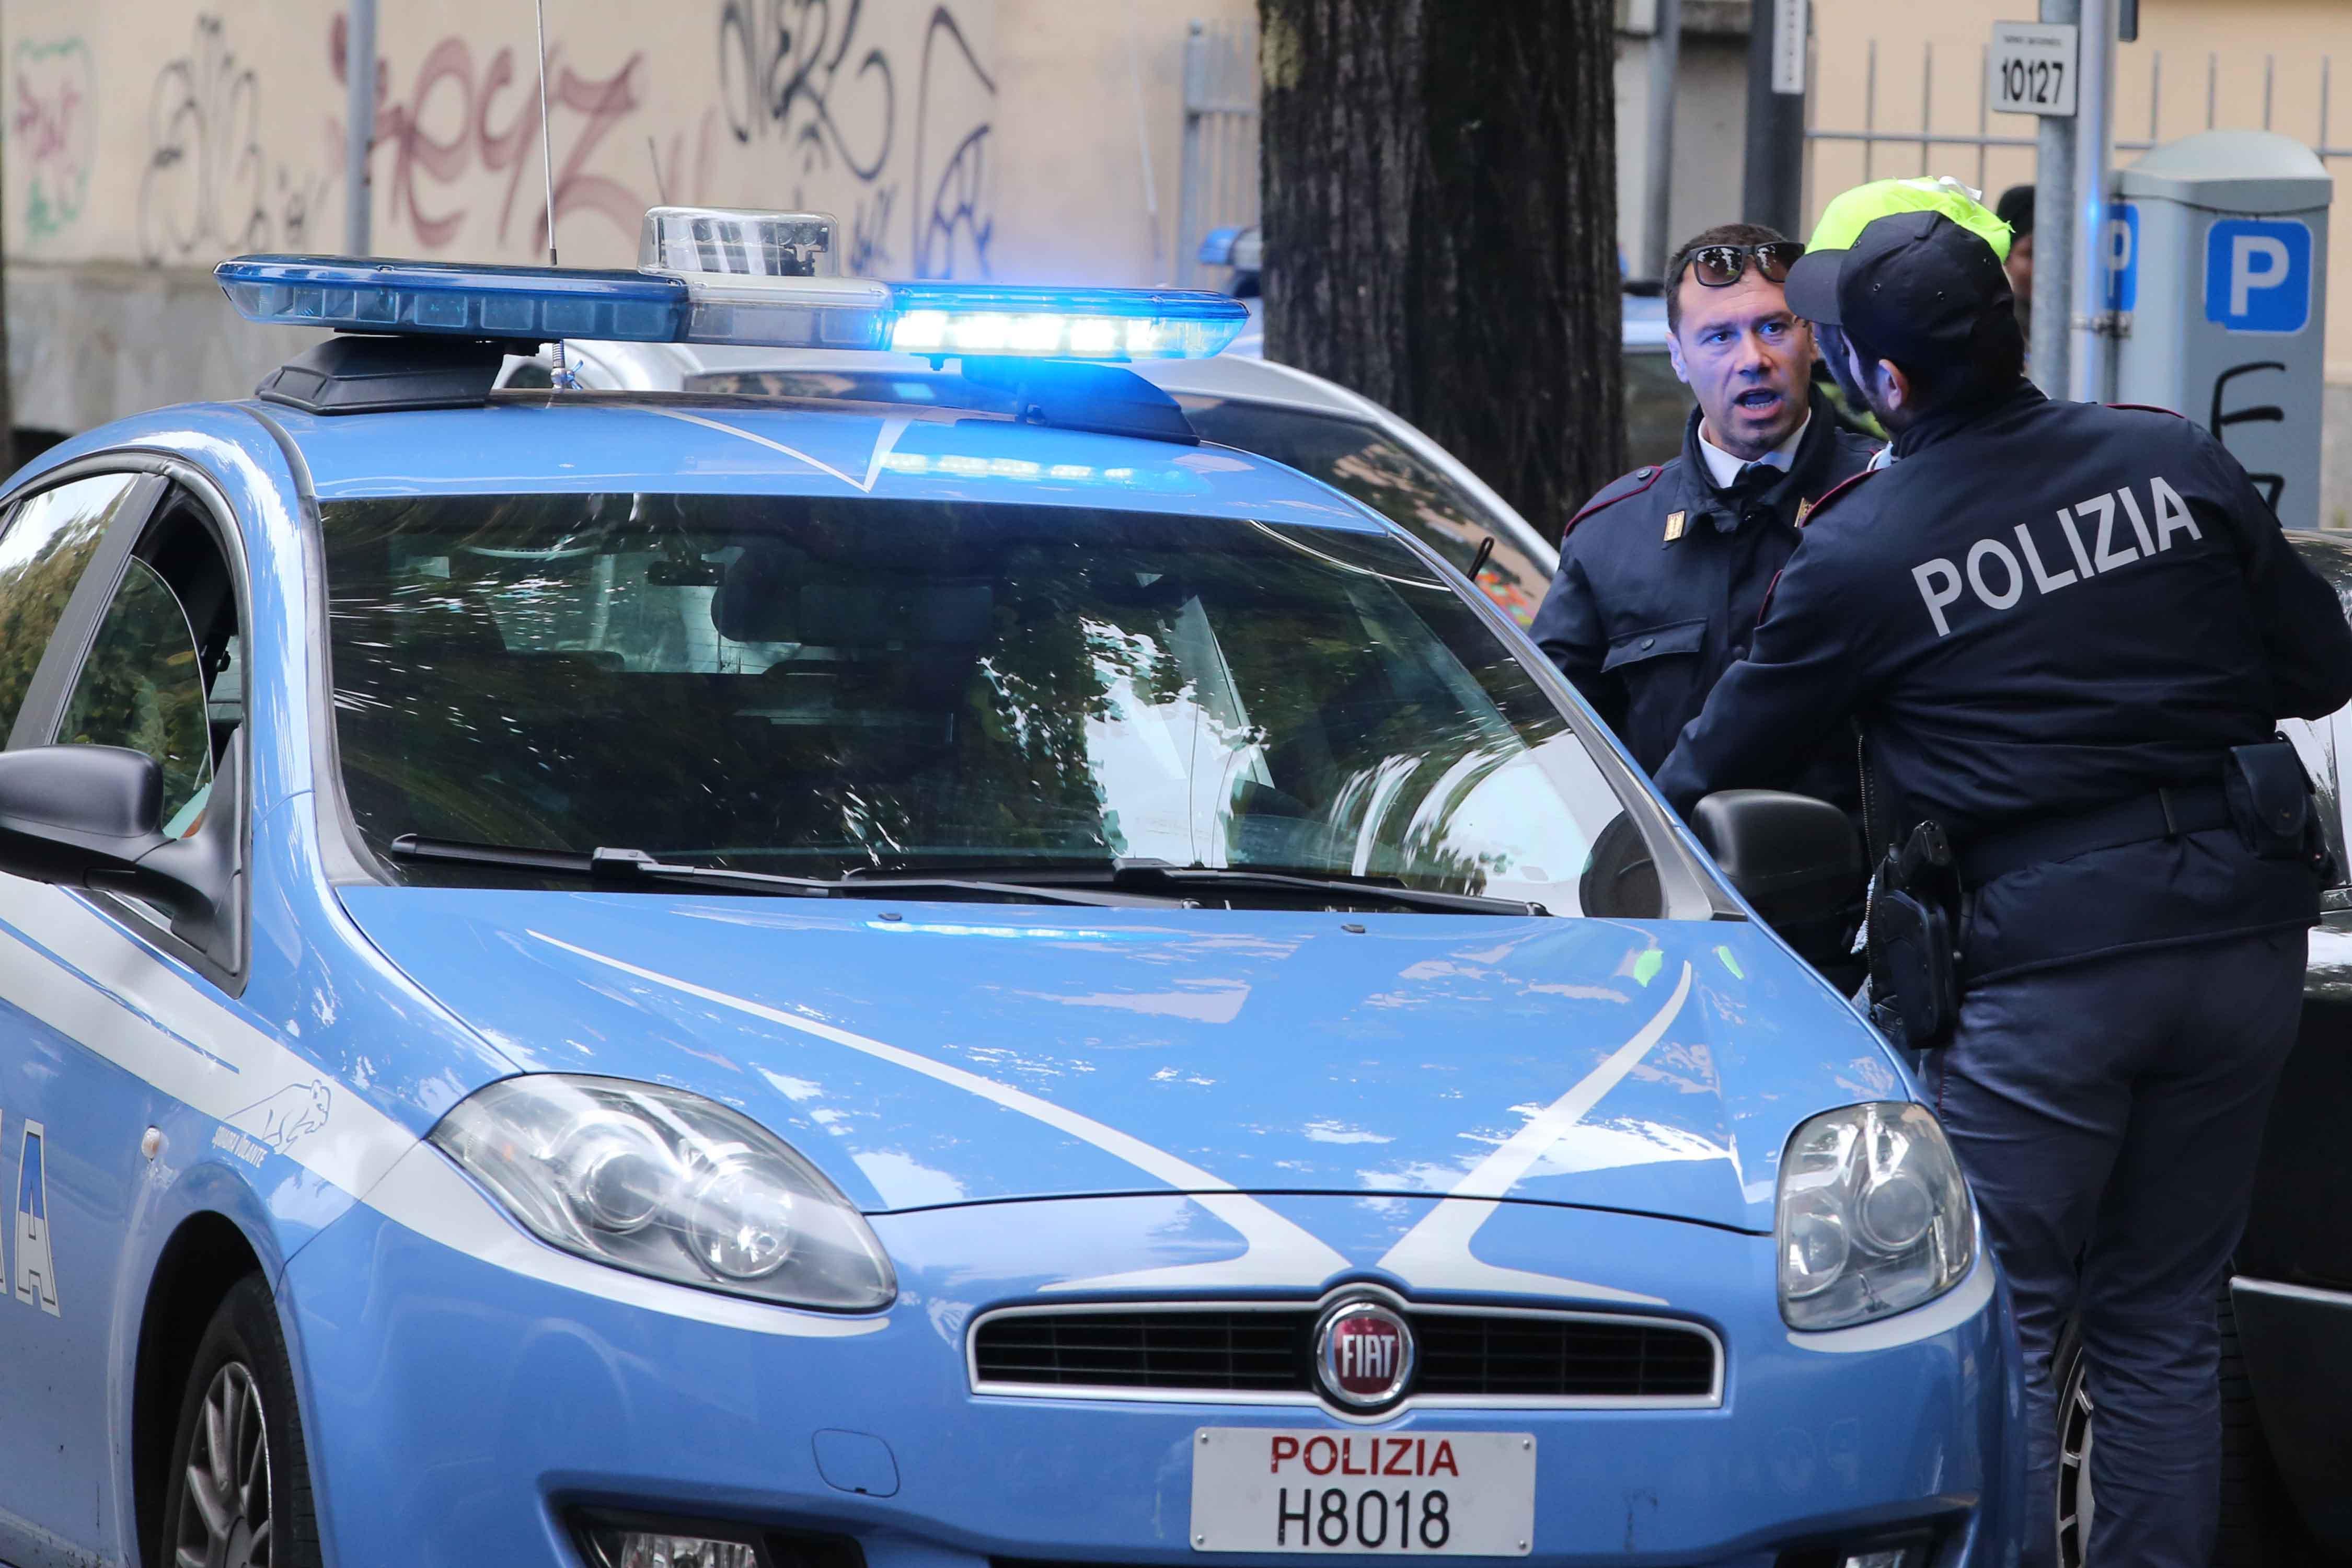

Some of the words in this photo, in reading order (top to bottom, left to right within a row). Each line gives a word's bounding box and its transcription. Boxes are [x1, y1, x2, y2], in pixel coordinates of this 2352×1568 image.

[2001, 58, 2063, 103] 10127
[2230, 235, 2290, 316] P
[1911, 476, 2203, 637] POLIZIA
[1341, 1334, 1396, 1378] FIAT
[1270, 1436, 1459, 1477] POLIZIA
[1277, 1488, 1450, 1549] H8018
